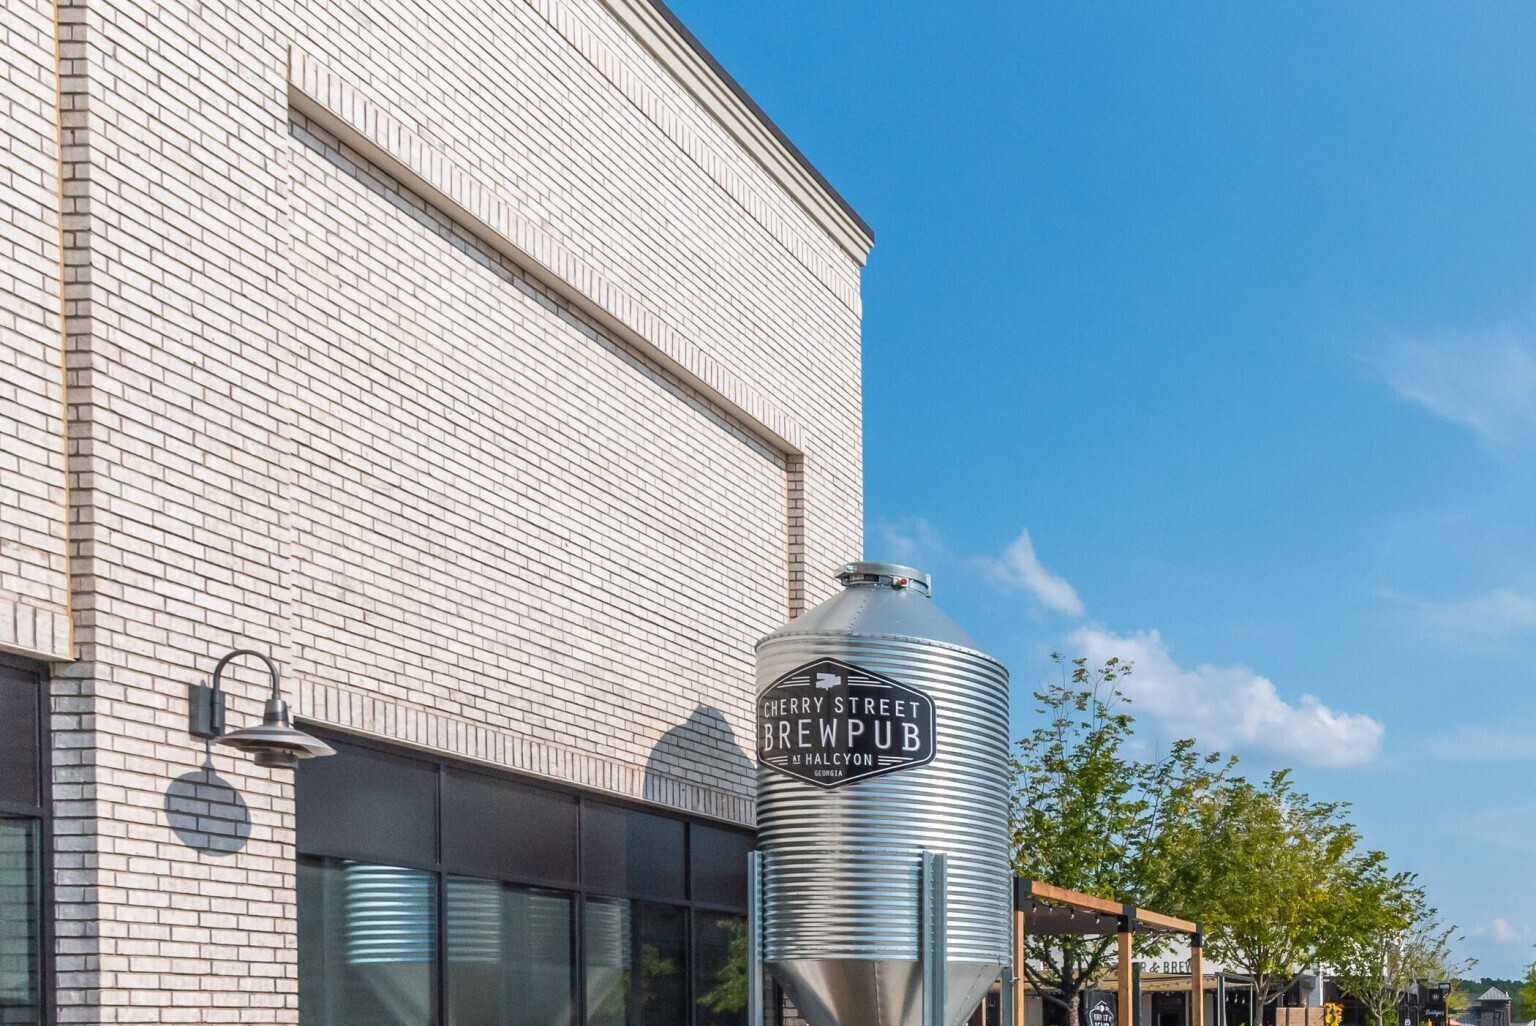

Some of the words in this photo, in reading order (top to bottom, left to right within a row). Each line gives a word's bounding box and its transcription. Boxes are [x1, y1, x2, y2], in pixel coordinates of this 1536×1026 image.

[764, 696, 824, 718] CHERRY
[834, 696, 920, 718] STREET
[764, 718, 921, 752] BREWPUB
[792, 754, 801, 763] AT
[805, 752, 873, 766] HALCYON
[814, 769, 843, 777] GEORGIA
